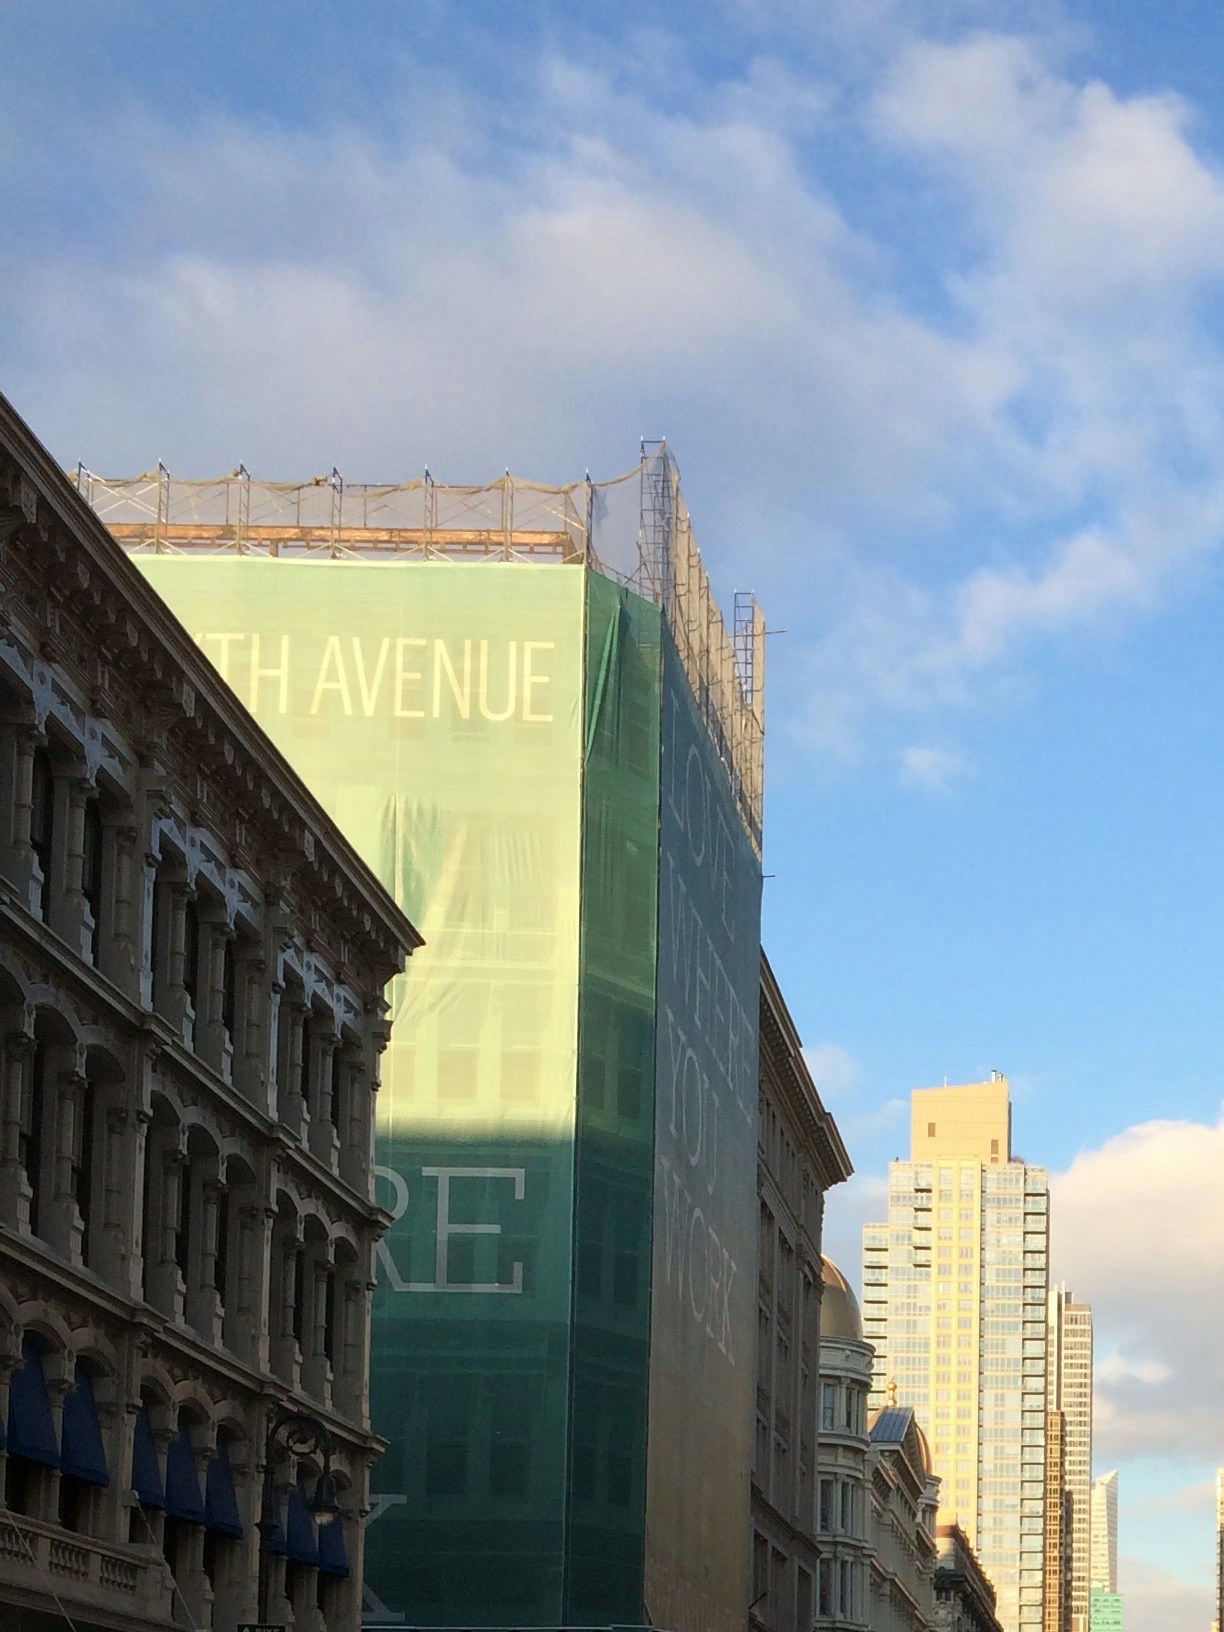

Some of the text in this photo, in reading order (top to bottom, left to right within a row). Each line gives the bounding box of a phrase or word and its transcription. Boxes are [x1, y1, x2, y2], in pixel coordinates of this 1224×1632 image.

[194, 633, 554, 721] TH AVENUE
[667, 679, 736, 953] LOVE
[663, 1000, 719, 1207] YOU
[659, 1152, 737, 1369] WORK
